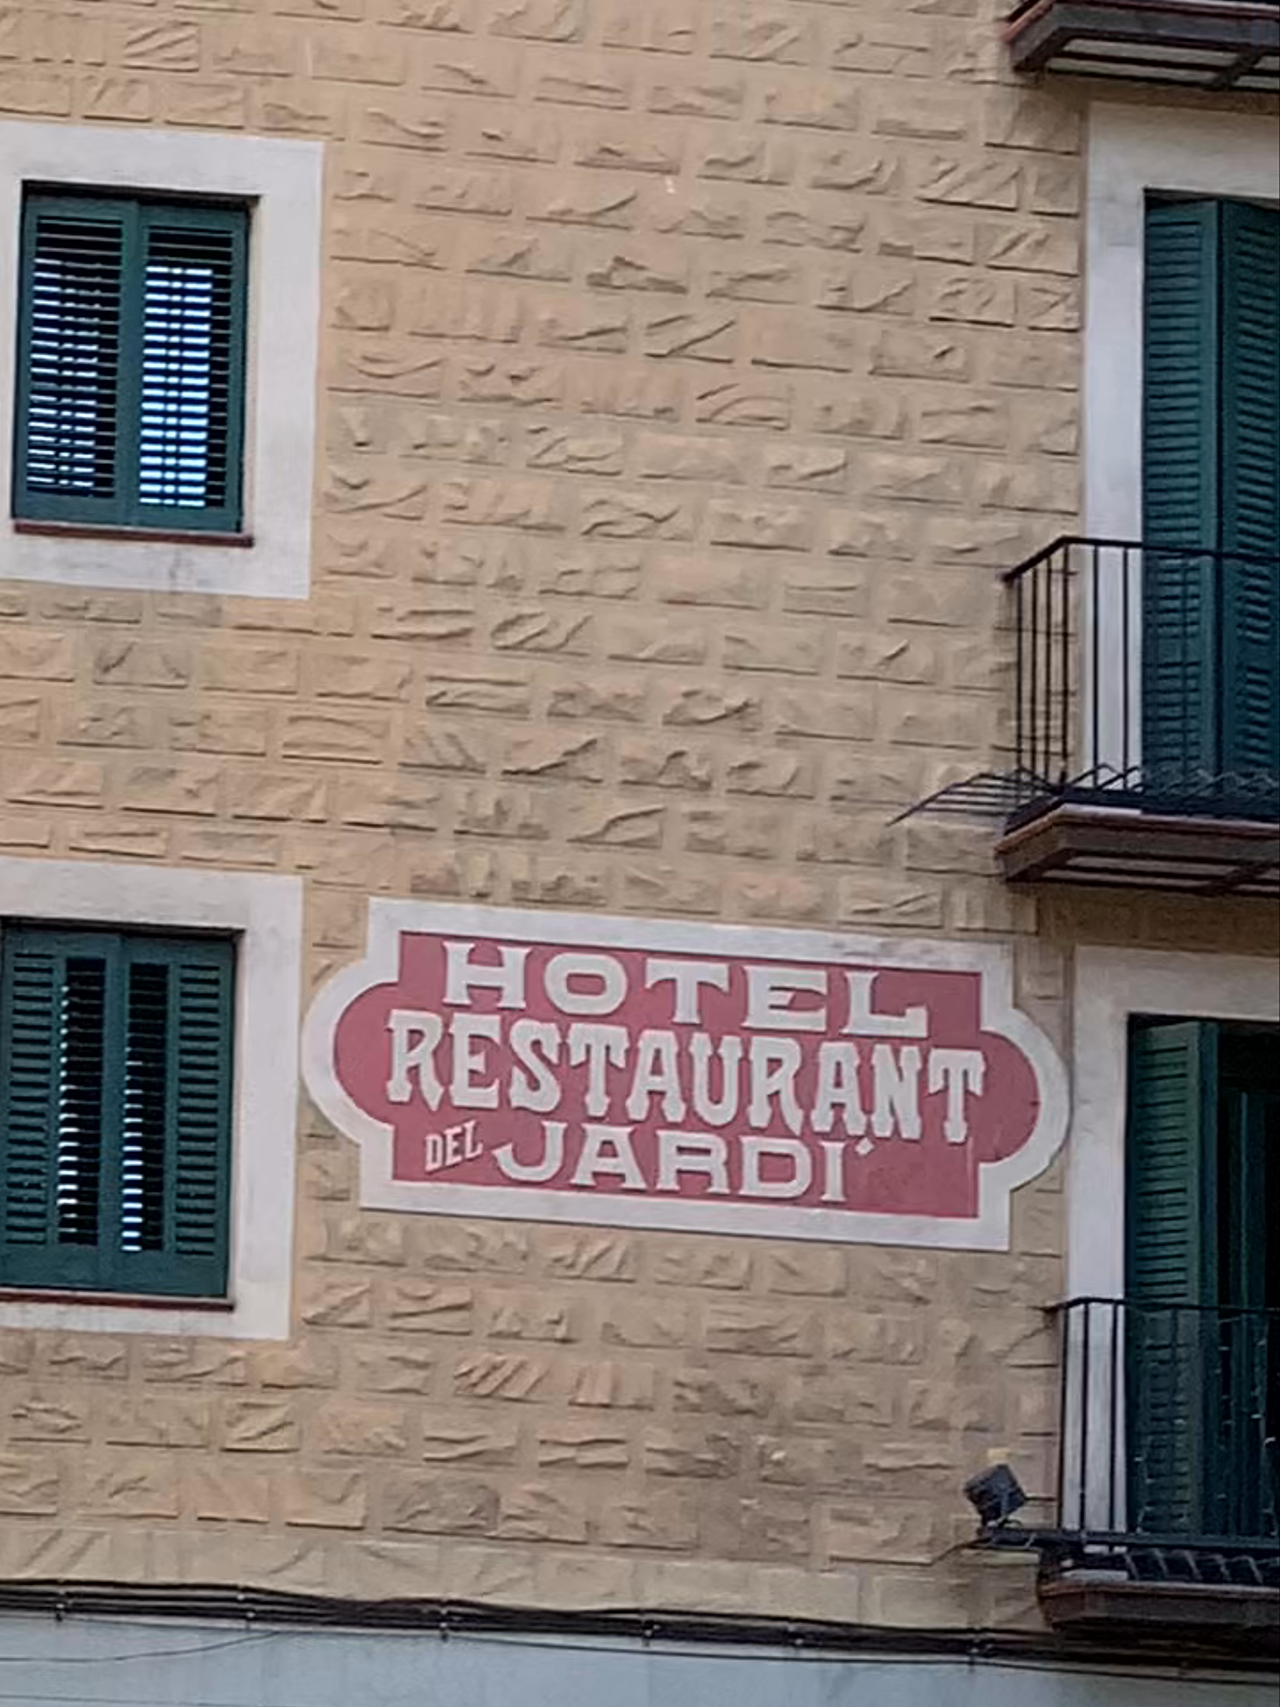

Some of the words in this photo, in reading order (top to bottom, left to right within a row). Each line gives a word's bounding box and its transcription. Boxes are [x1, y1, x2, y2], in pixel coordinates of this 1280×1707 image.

[442, 940, 929, 1039] HOTEL
[385, 1009, 985, 1143] RESTAURANT
[424, 1119, 484, 1173] DEL
